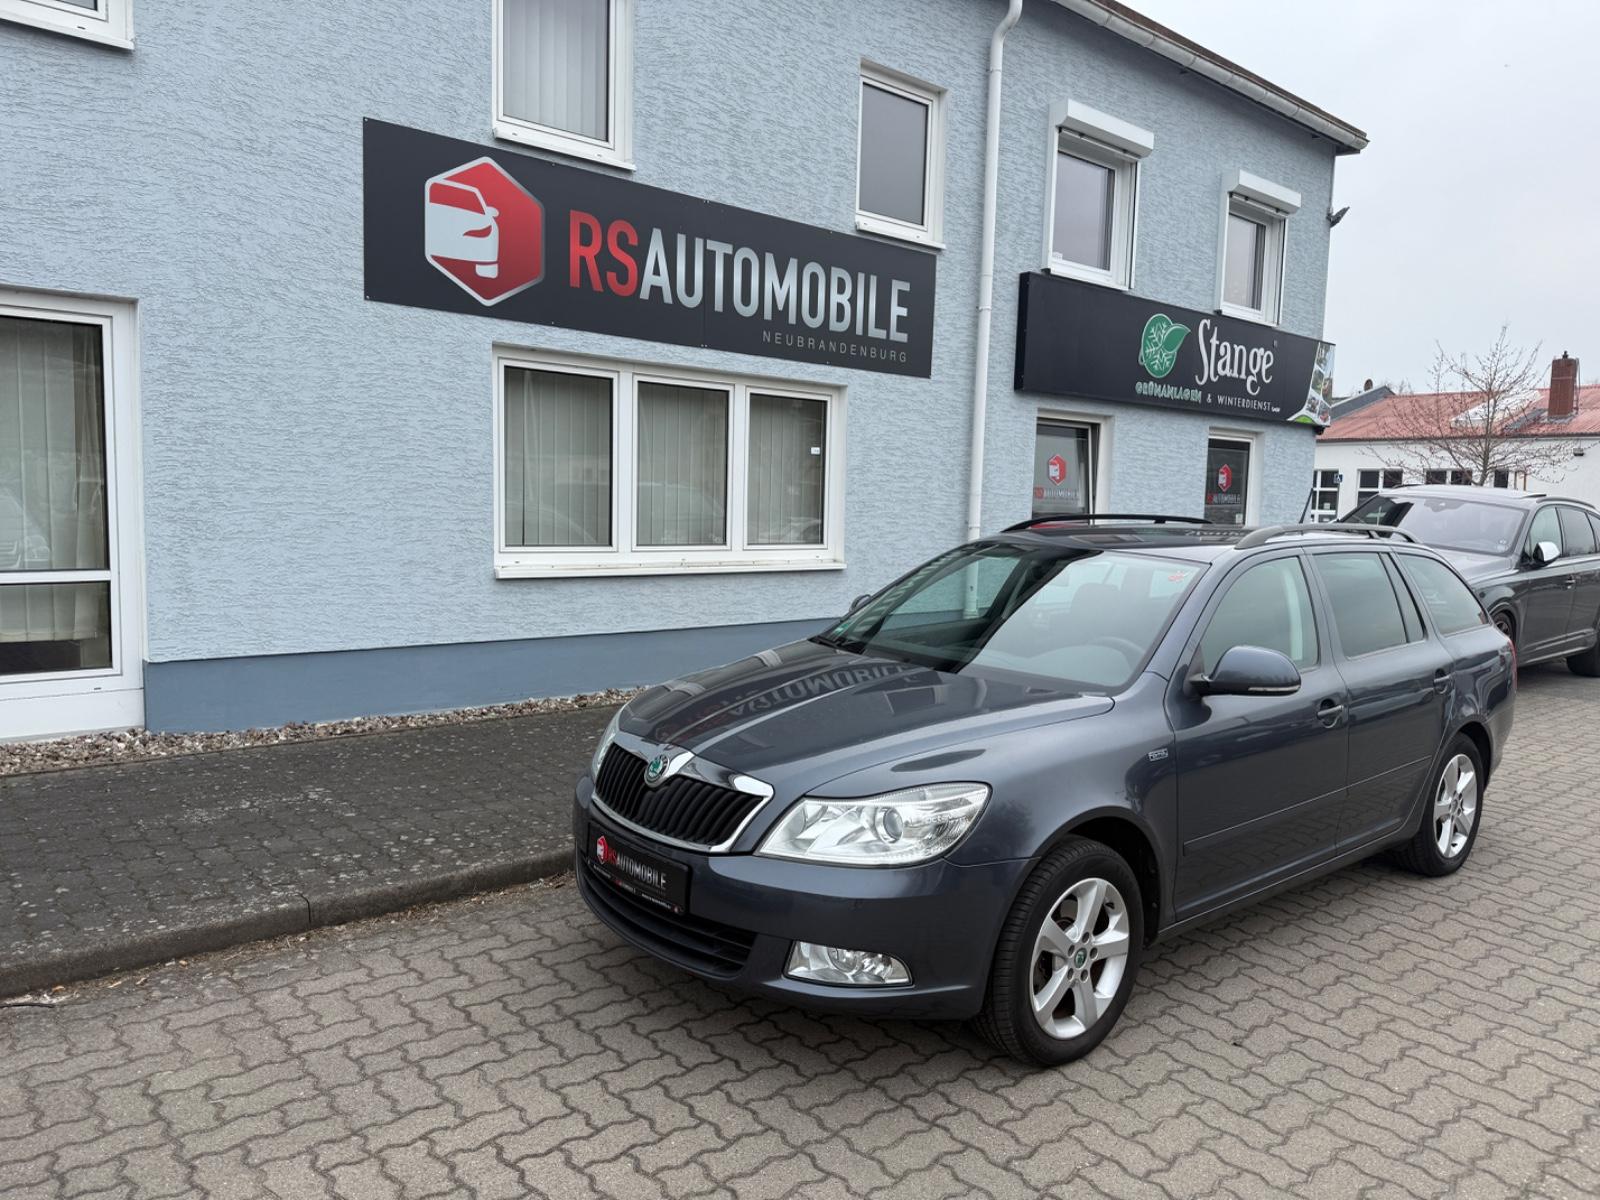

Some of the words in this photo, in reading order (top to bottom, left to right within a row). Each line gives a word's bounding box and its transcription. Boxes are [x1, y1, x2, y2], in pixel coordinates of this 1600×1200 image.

[569, 210, 910, 342] RSAUTOMOBILE
[762, 330, 907, 363] NEUBRANDENBURG
[1195, 318, 1274, 396] Stange
[1206, 393, 1212, 403] &
[1217, 395, 1271, 411] WINTERDIENST
